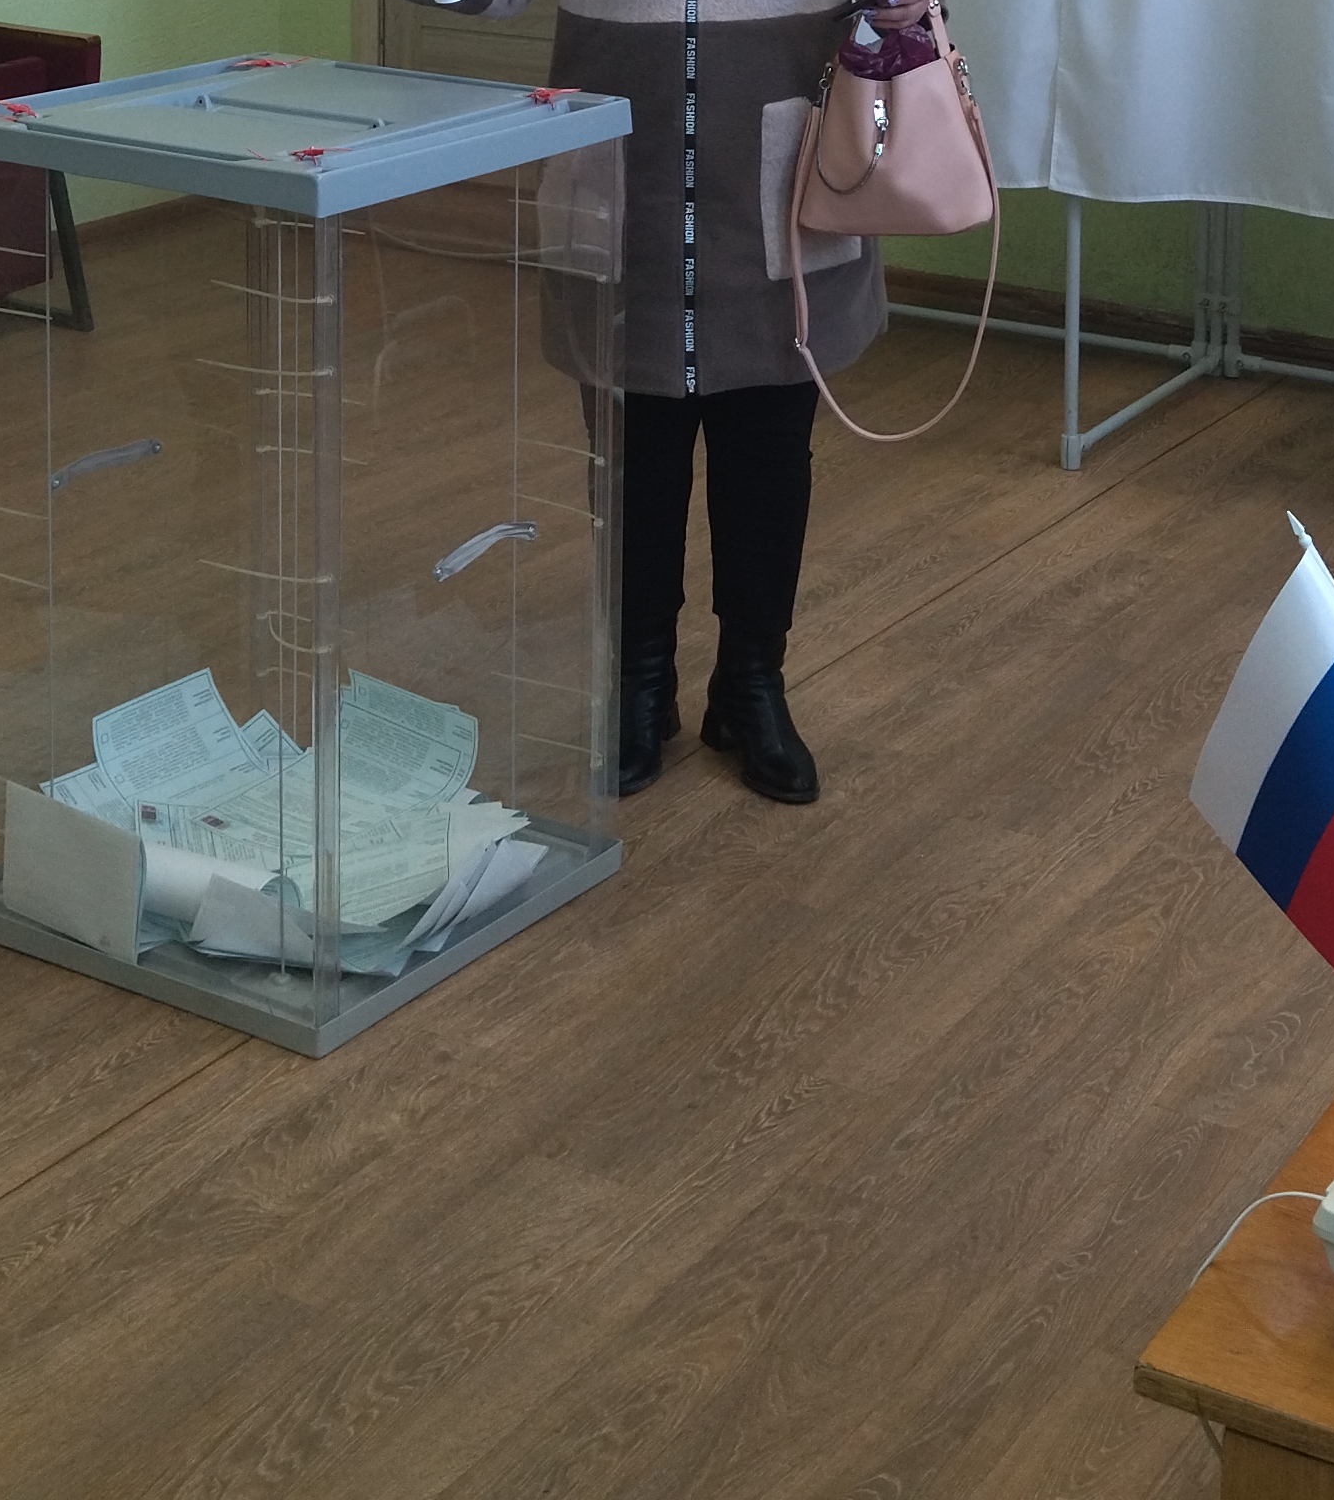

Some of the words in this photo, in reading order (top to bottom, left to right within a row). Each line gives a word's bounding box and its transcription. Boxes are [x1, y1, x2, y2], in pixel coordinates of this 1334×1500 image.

[687, 38, 695, 80] FASHION
[686, 93, 695, 135] FASHION
[686, 149, 694, 188] FASHION
[685, 202, 694, 244] FASHION
[685, 258, 695, 296] FASHION
[685, 310, 694, 352] FASHION
